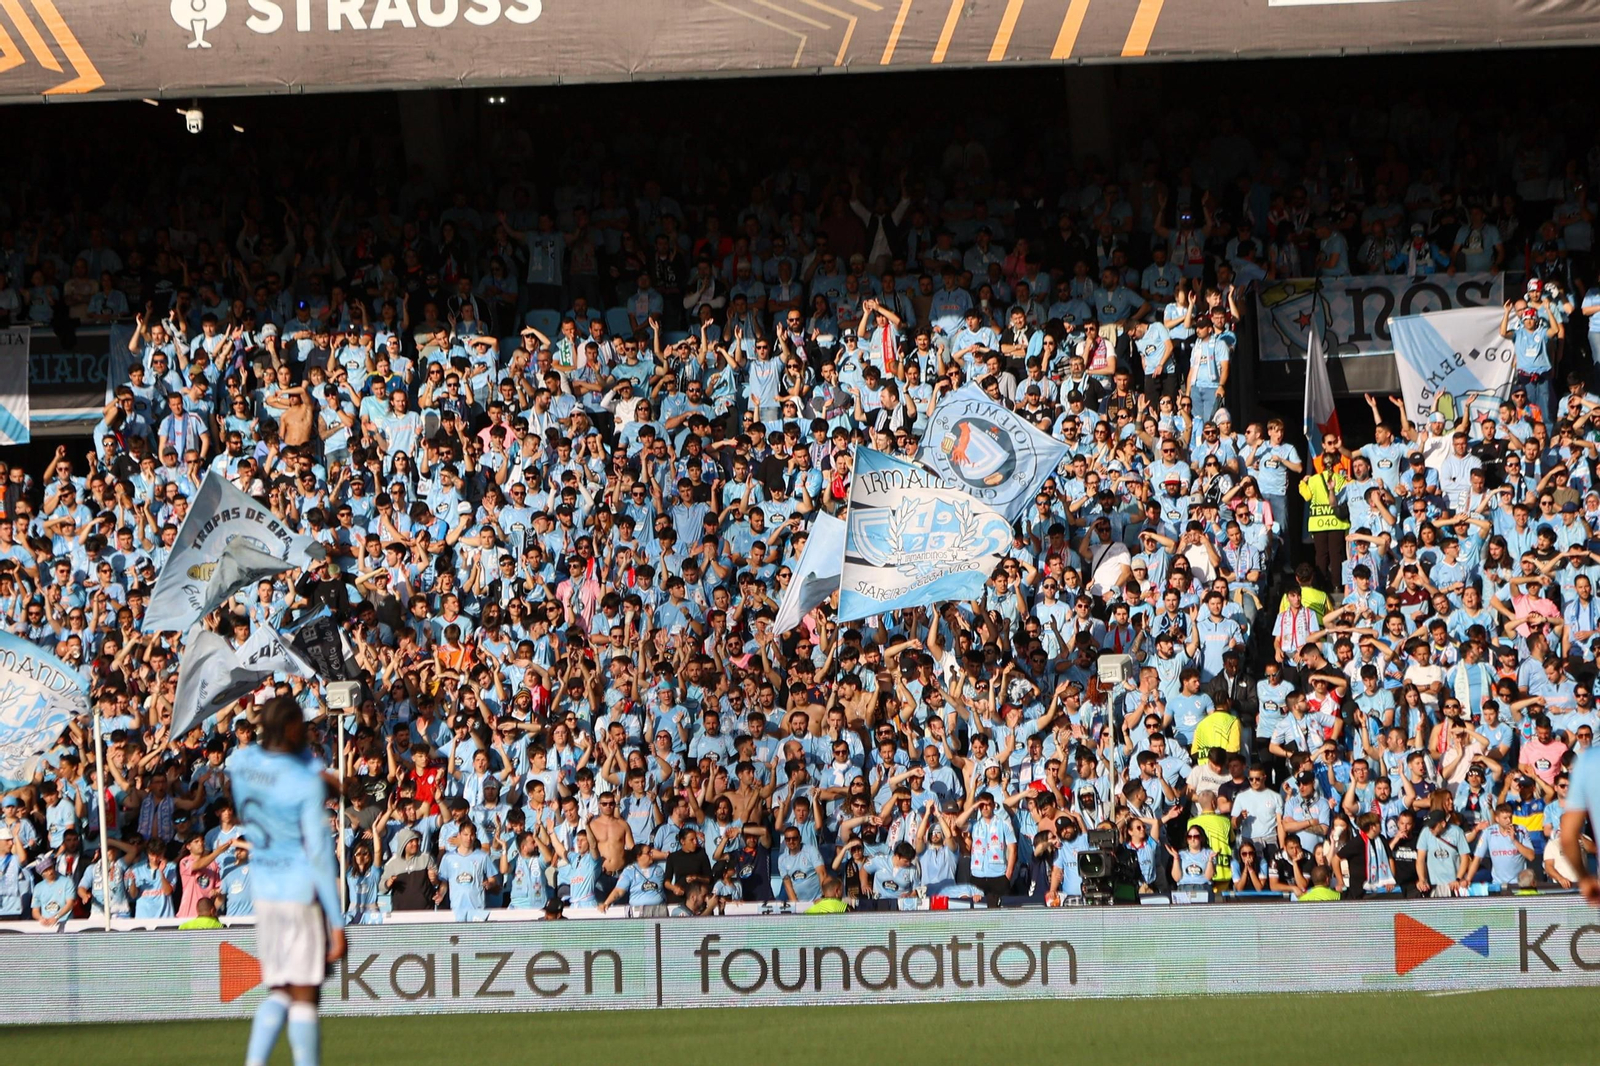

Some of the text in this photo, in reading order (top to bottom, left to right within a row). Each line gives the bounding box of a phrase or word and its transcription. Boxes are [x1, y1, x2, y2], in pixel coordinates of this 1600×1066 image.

[192, 507, 241, 549] TROPAS
[245, 507, 267, 524] DE
[1317, 518, 1339, 528] 040
[341, 931, 1077, 1001] kaizen foundation
